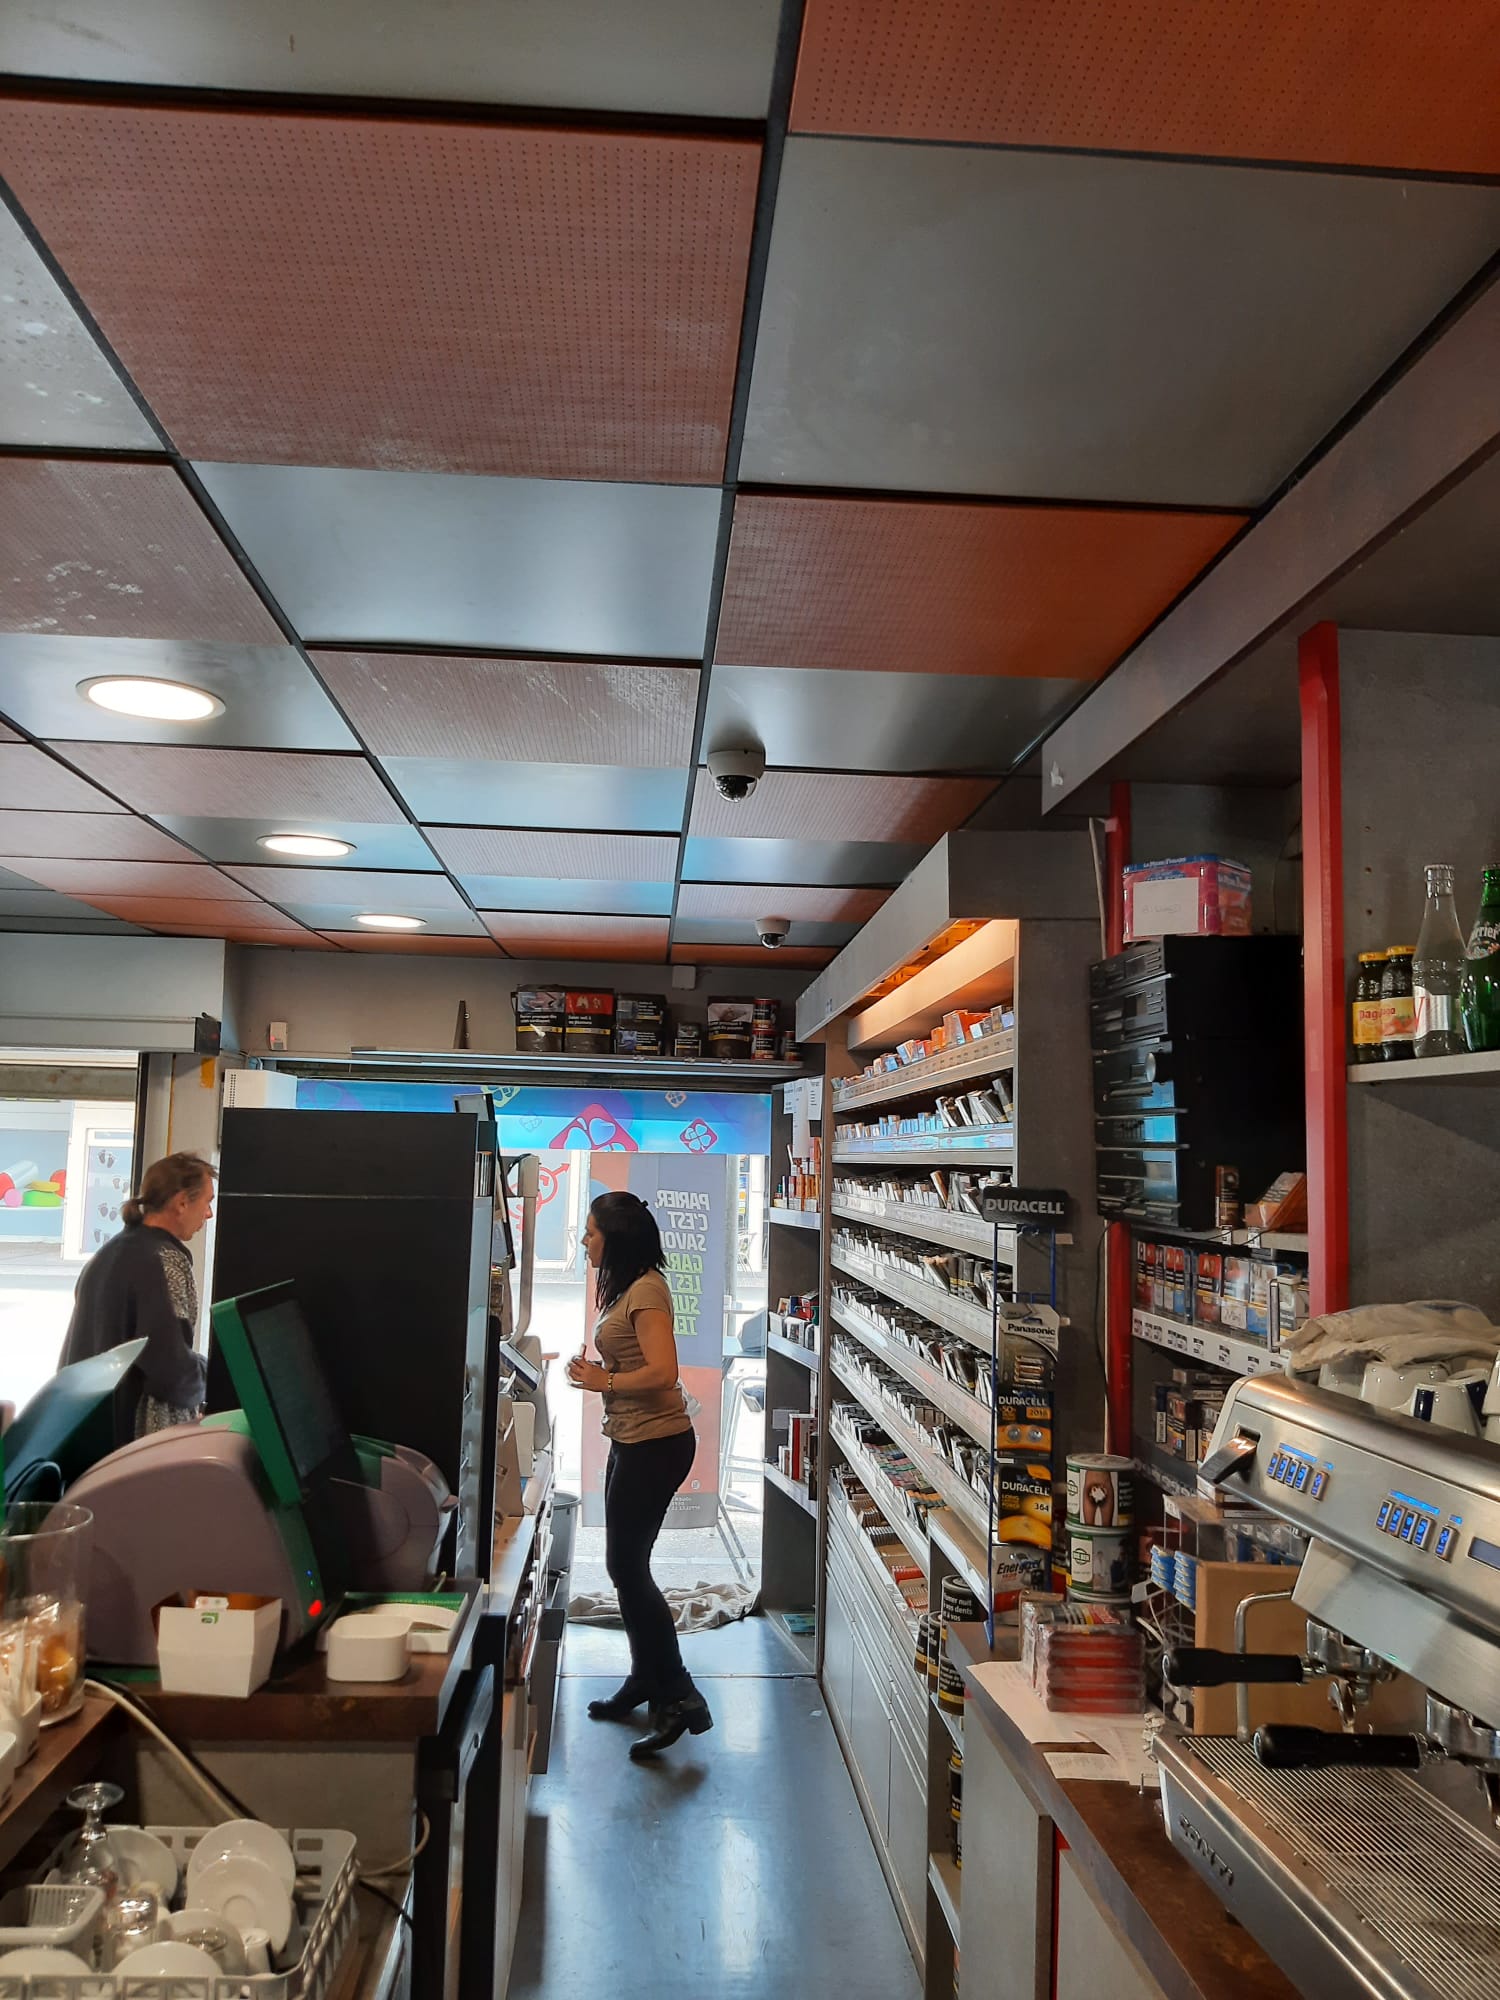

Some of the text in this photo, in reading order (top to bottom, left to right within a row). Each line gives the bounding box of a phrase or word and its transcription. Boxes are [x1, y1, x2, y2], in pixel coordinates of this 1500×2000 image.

[985, 1198, 1065, 1215] DURACELL
[1007, 1323, 1056, 1335] Panasonic
[998, 1396, 1047, 1407] DURACELL
[1002, 1481, 1050, 1497] DURACELL
[1034, 1502, 1049, 1512] 364
[954, 1605, 973, 1616] dents
